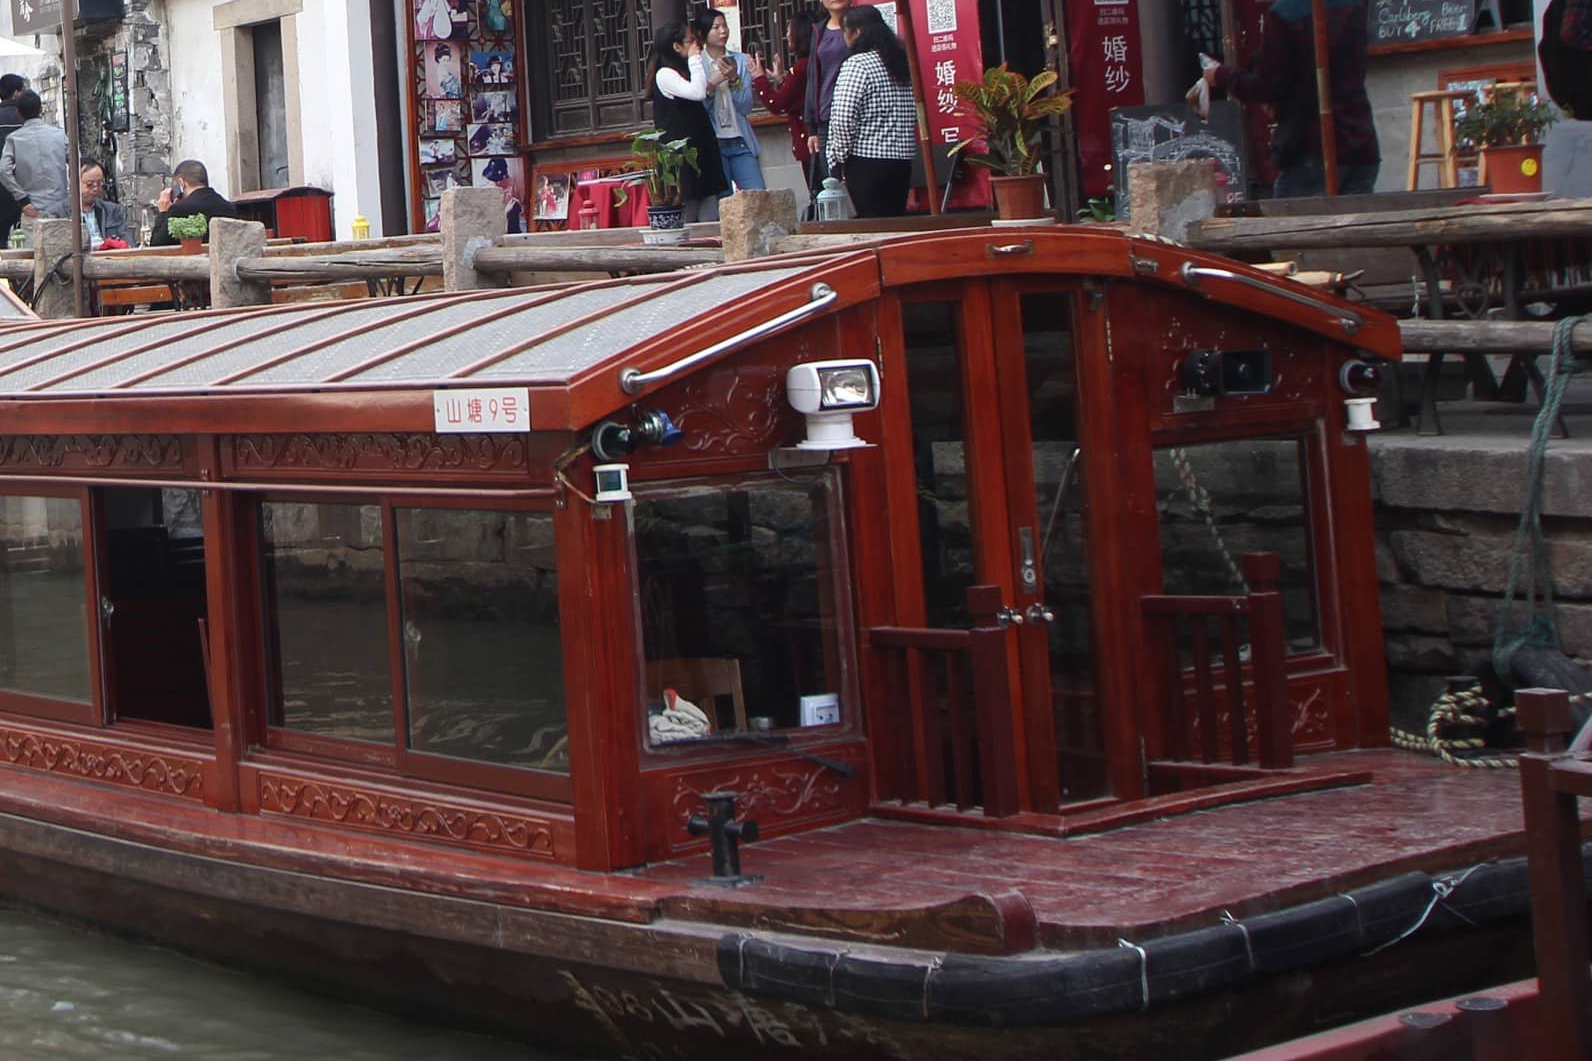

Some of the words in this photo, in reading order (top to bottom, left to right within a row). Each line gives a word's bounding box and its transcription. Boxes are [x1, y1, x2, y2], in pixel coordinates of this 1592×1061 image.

[1378, 25, 1403, 39] BUY
[1102, 35, 1130, 93] 婚纱
[446, 396, 518, 424] 山塘9号
